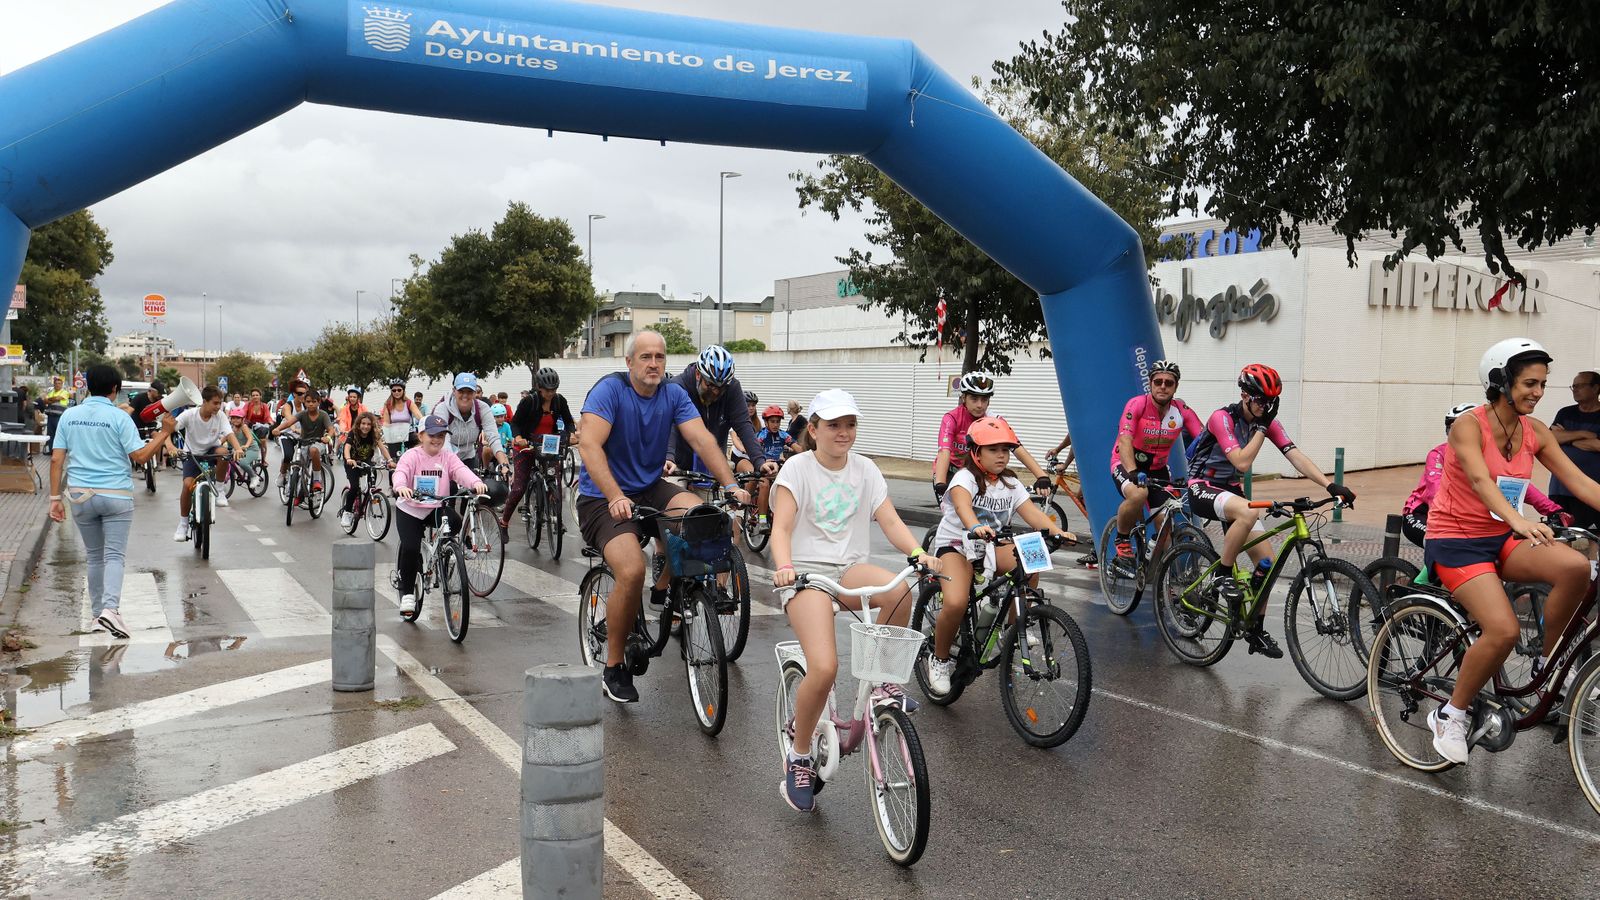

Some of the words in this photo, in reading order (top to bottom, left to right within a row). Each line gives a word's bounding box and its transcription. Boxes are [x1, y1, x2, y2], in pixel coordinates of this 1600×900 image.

[425, 19, 704, 68] Ayuntamiento
[713, 55, 755, 73] de
[764, 59, 853, 82] Jerez
[425, 41, 559, 71] Deportes
[1368, 260, 1549, 313] HIPERCOR
